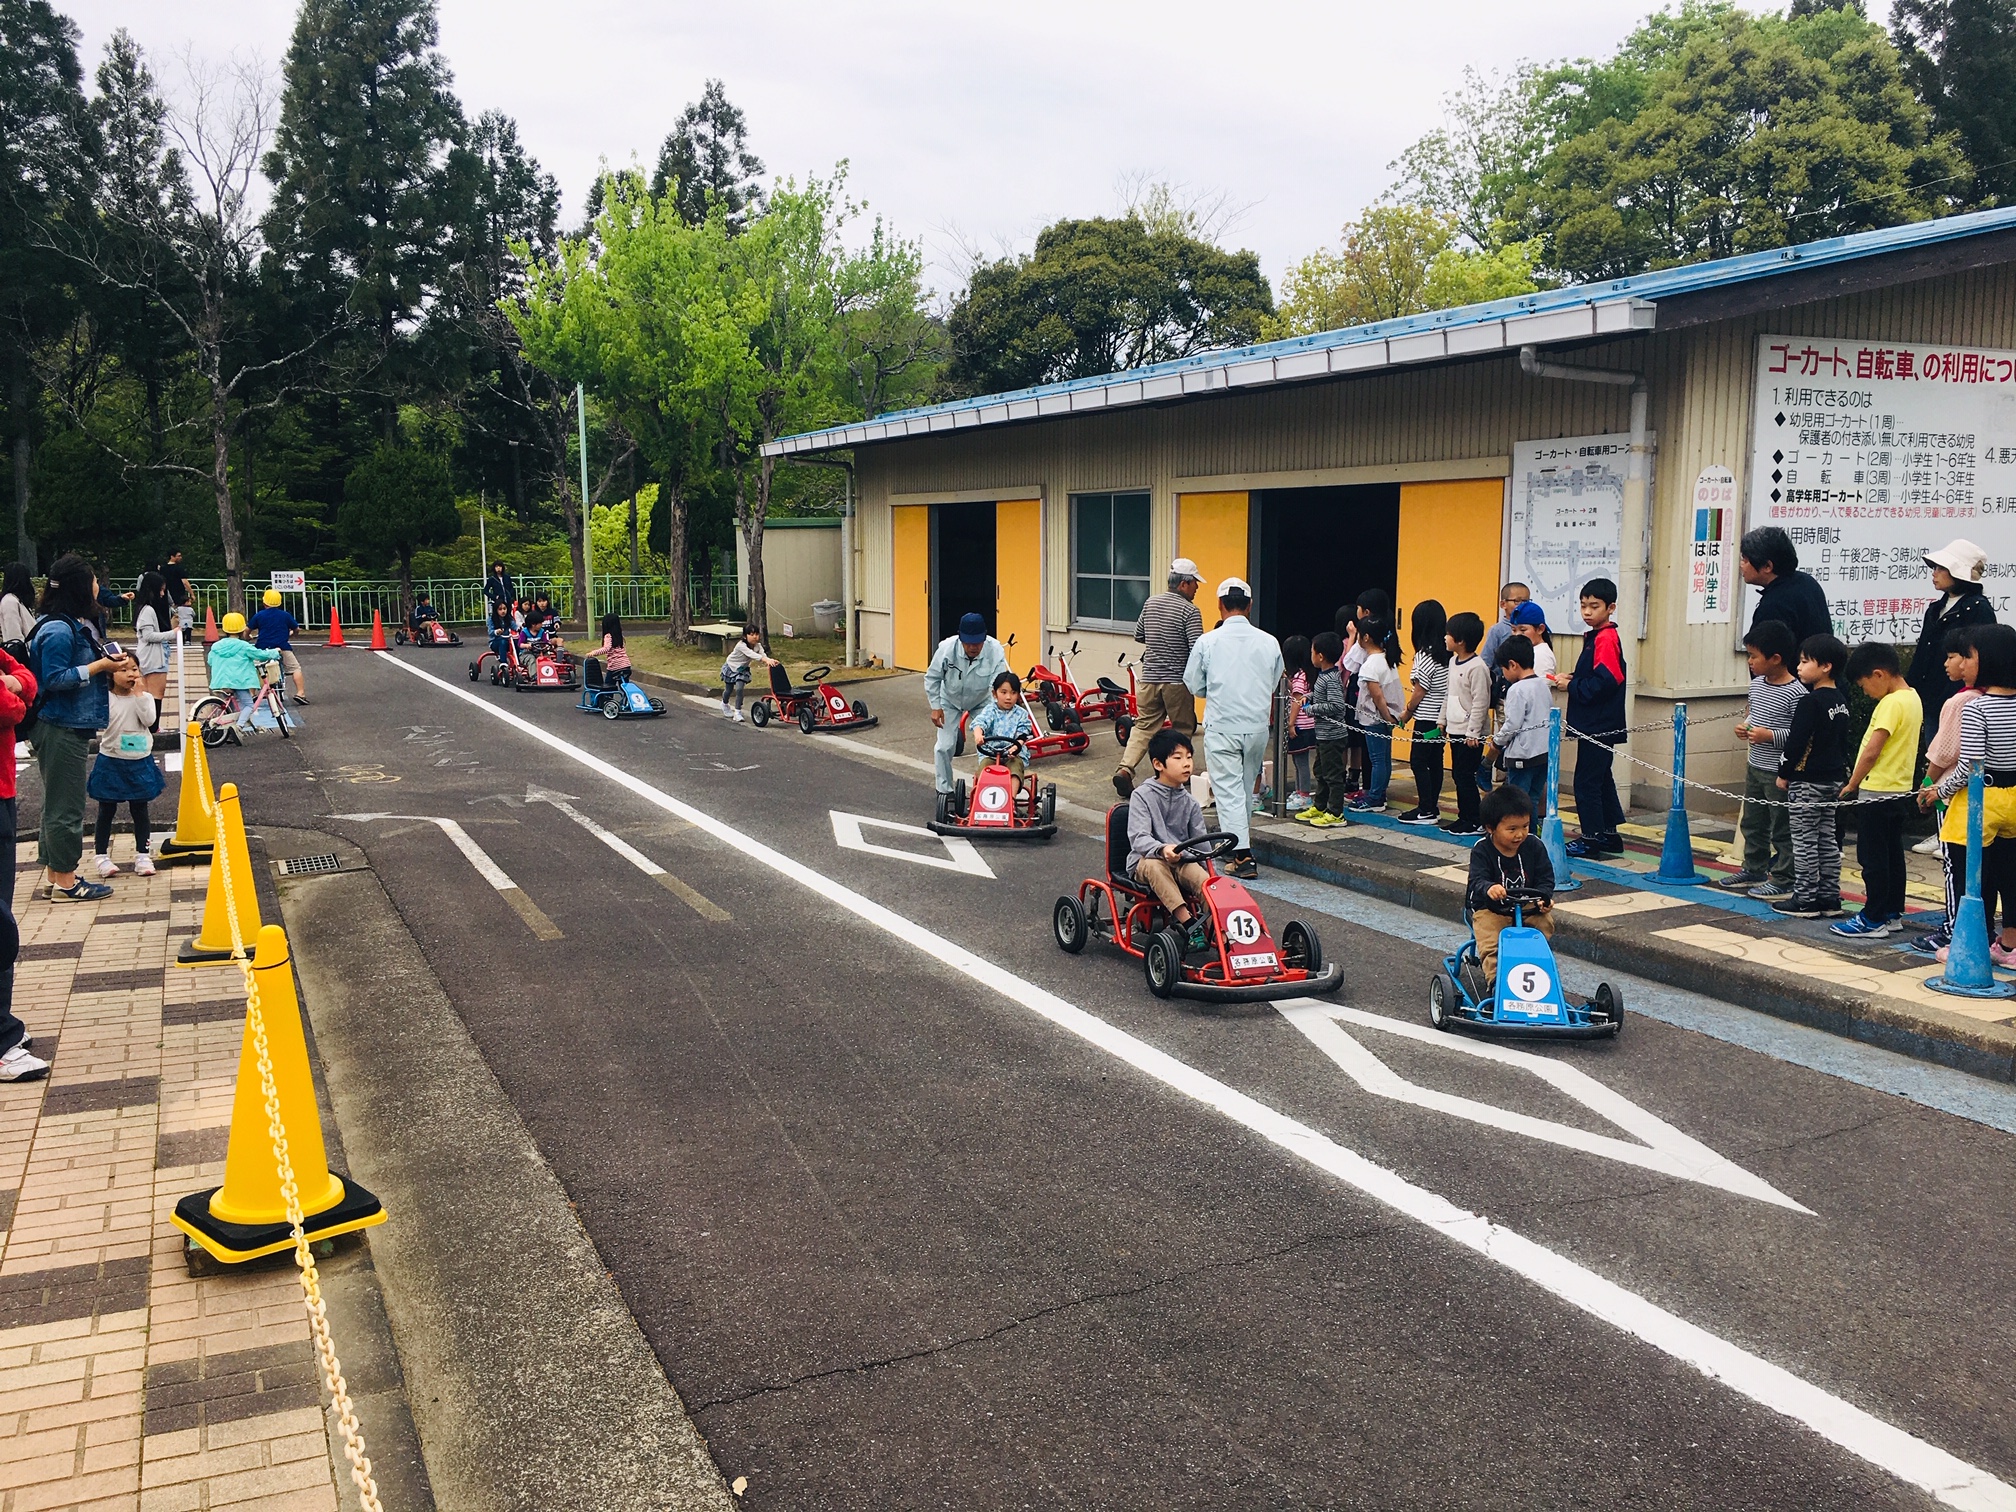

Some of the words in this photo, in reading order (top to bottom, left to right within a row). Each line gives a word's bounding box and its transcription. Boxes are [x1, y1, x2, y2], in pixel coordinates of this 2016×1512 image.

[1769, 344, 2016, 383] ゴーカート、自転車、の利用につ
[1698, 487, 1732, 502] のりば
[835, 699, 841, 708] 6
[989, 791, 997, 805] 1
[1233, 915, 1254, 938] 13
[1522, 971, 1536, 993] 5
